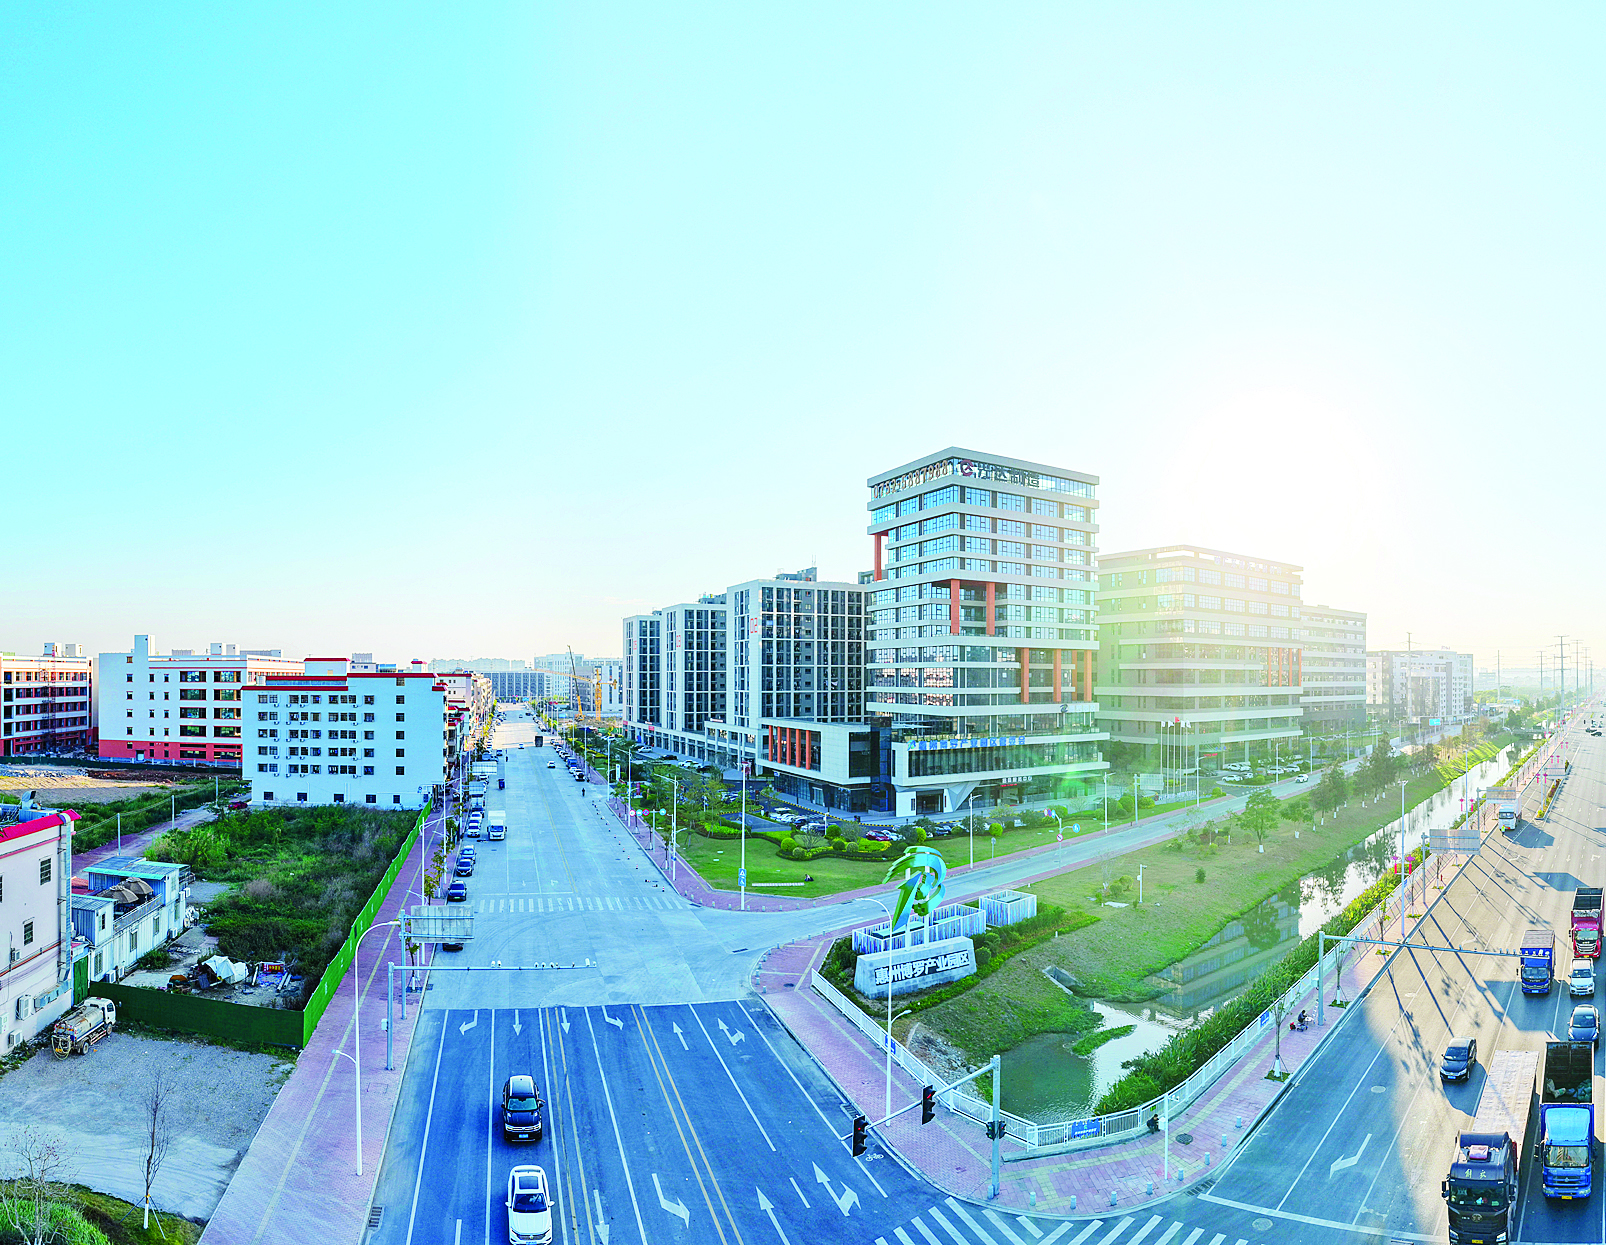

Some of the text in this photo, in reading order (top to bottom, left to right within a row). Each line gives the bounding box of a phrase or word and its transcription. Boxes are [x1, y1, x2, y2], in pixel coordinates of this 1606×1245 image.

[875, 951, 970, 985] 惠州博罗产业园区
